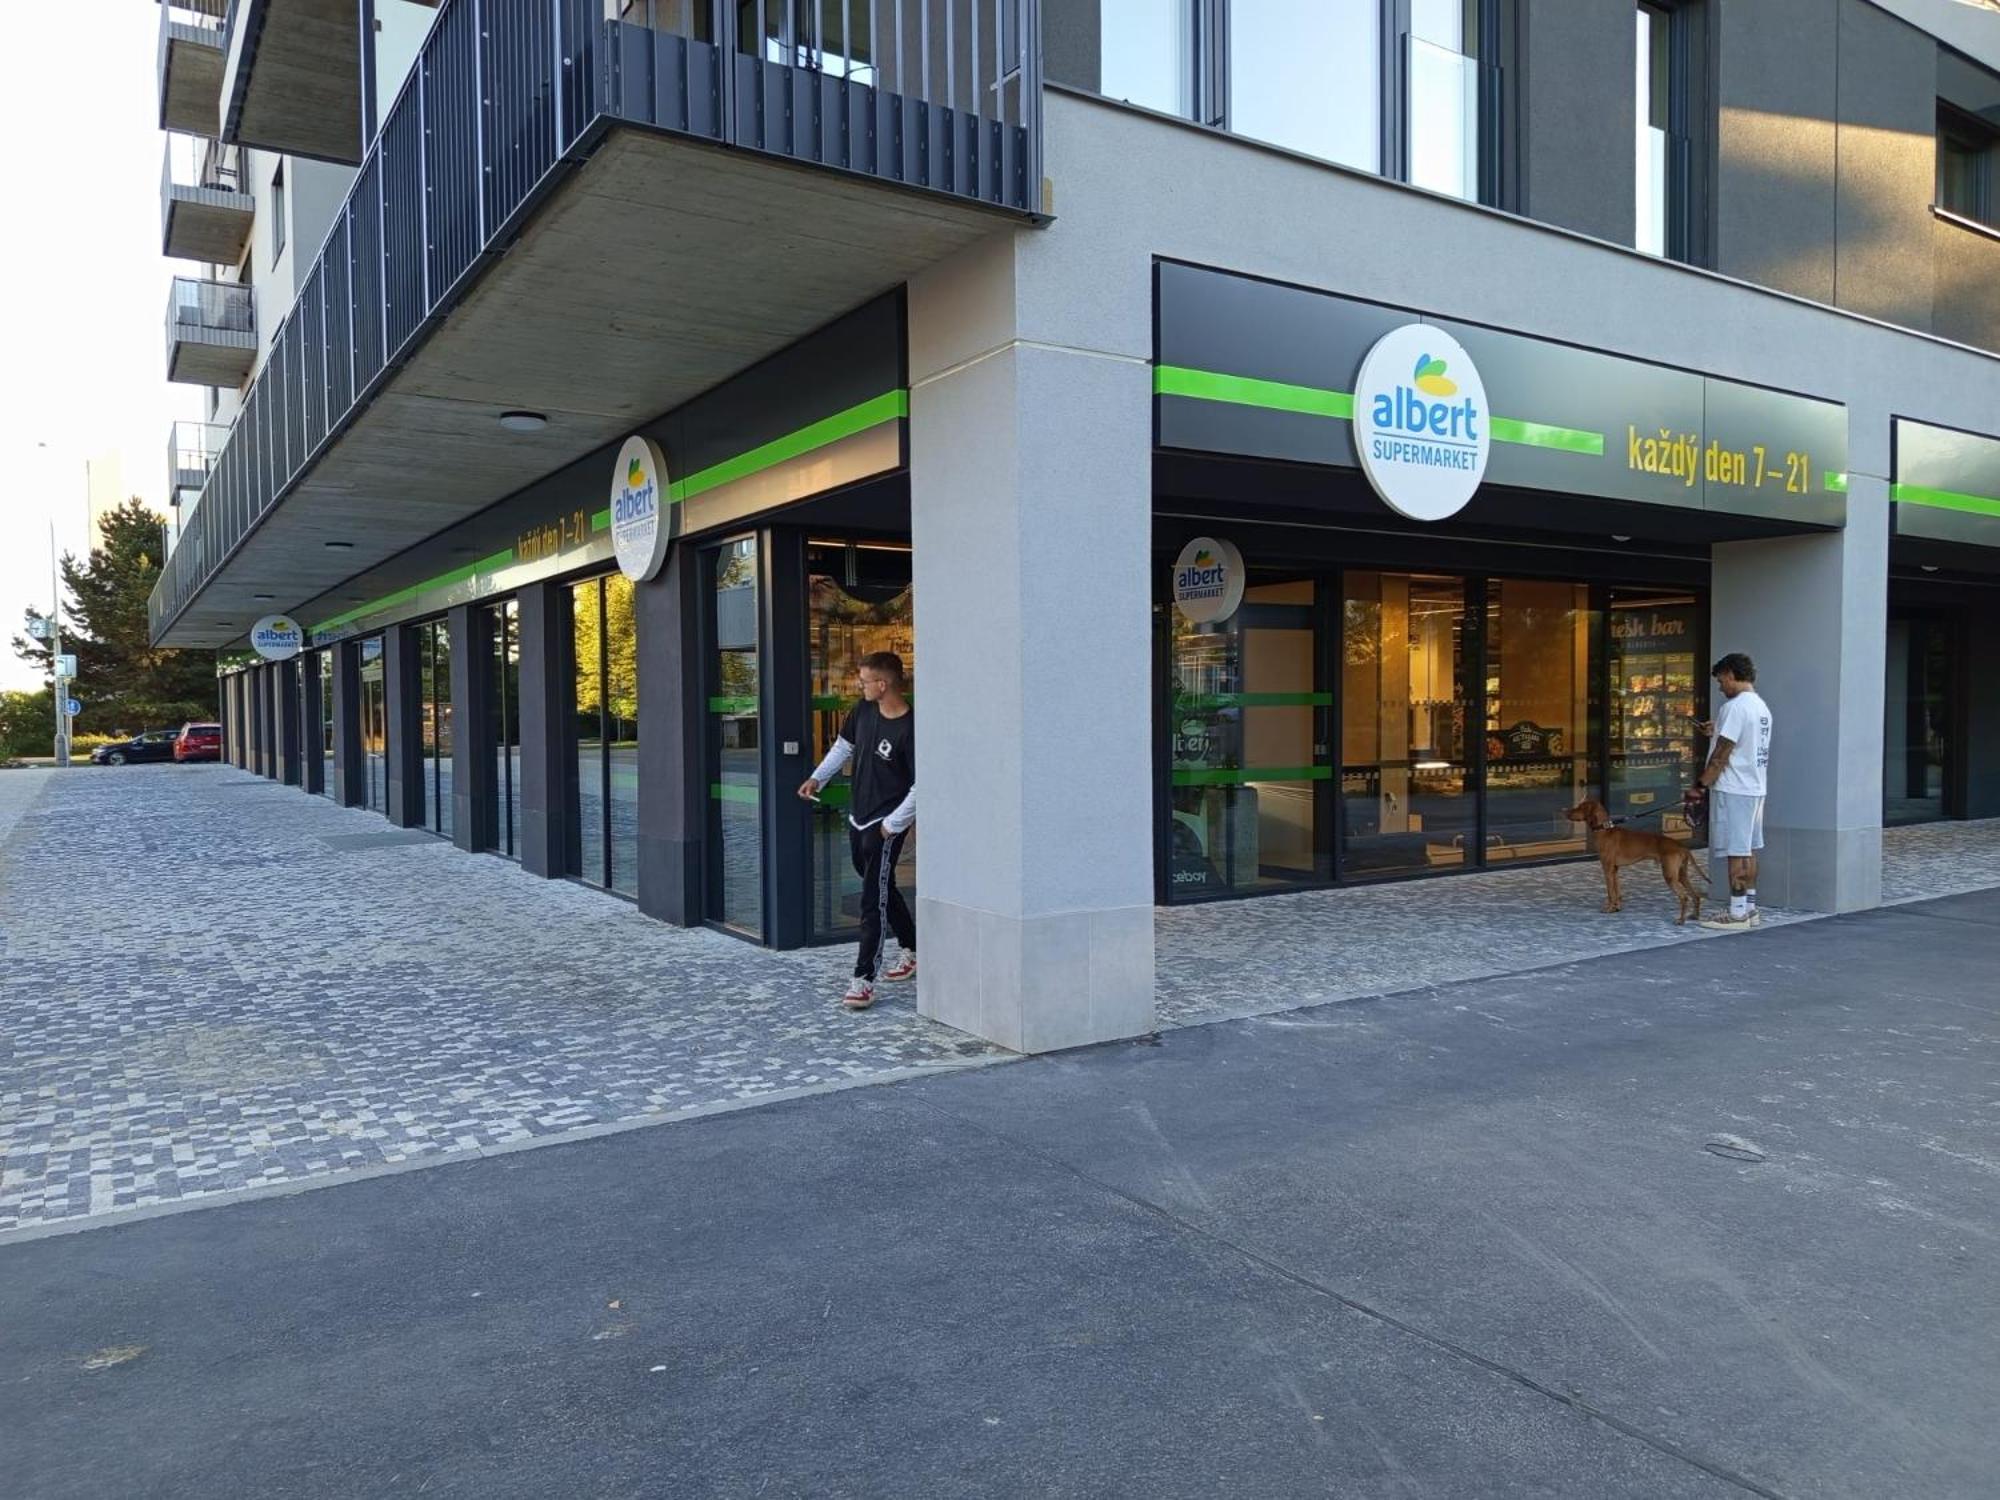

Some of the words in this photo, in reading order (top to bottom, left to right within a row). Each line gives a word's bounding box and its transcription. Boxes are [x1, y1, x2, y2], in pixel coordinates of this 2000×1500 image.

[1373, 385, 1477, 441] albert
[1373, 439, 1478, 471] SUPERMARKET
[1628, 424, 1698, 487] každý
[1704, 439, 1745, 486] den
[615, 478, 655, 523] albert
[1179, 562, 1225, 588] albert
[257, 629, 299, 641] albert
